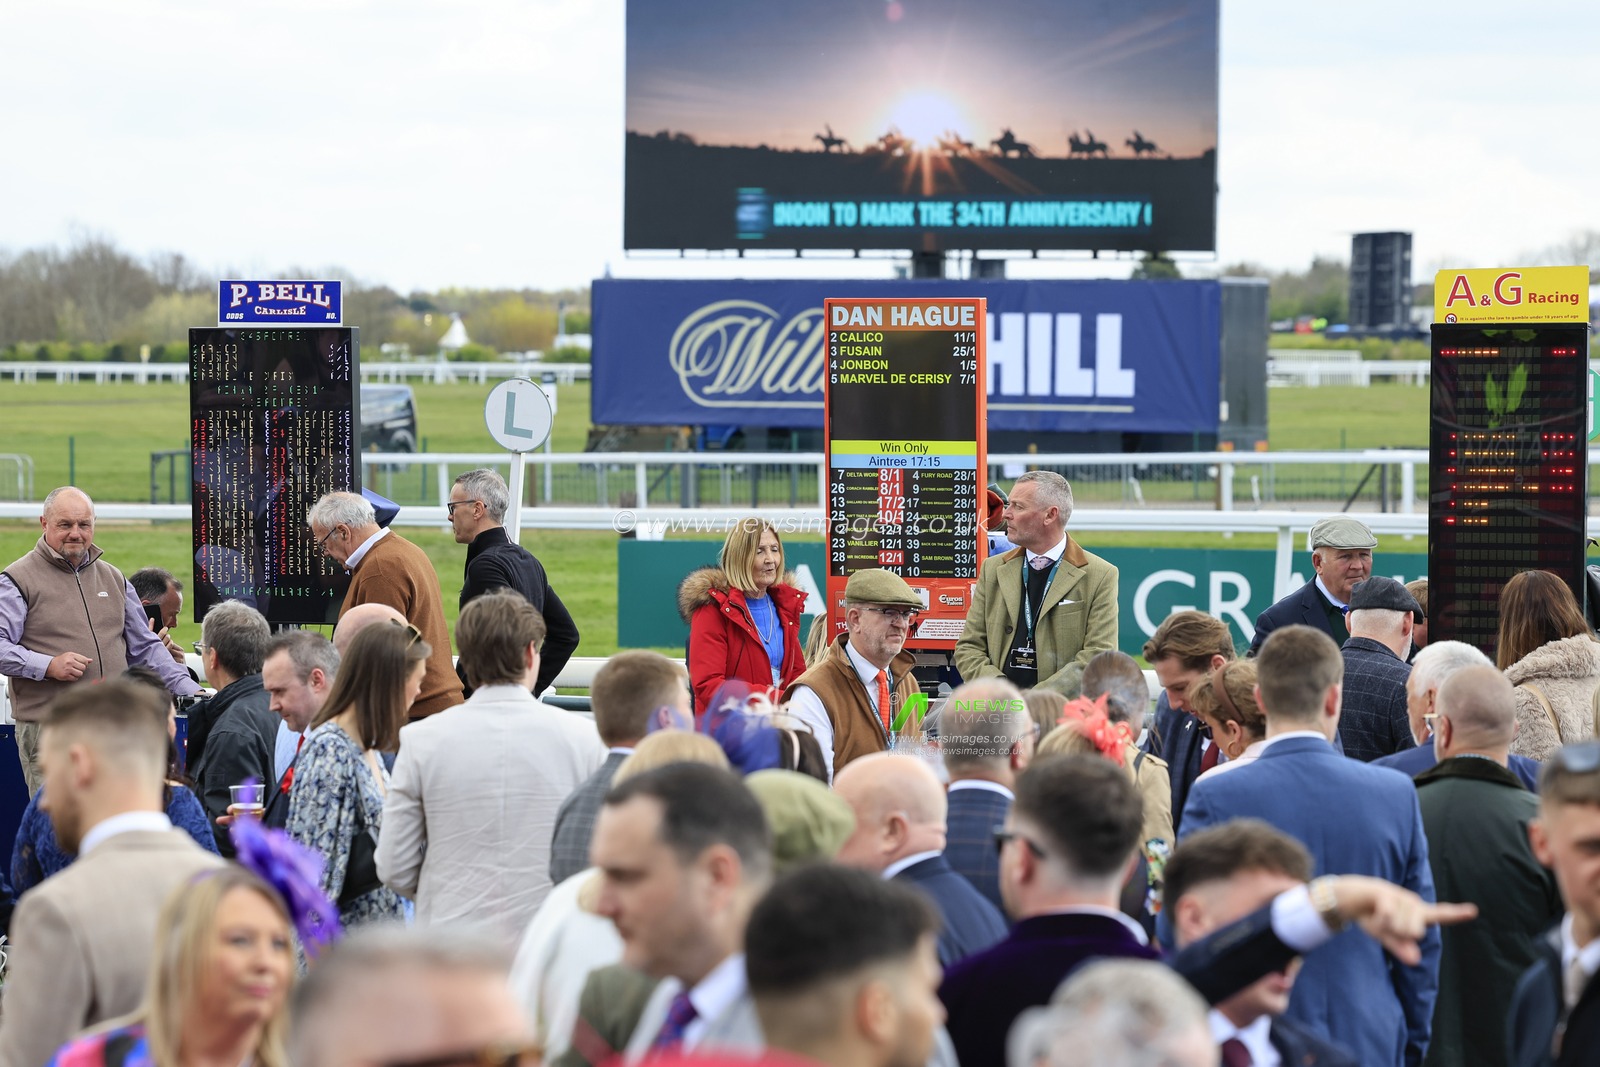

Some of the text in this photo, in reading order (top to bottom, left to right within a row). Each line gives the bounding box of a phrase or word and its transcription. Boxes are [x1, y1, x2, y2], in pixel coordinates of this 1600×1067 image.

[773, 202, 830, 227] NOON
[832, 202, 858, 227] TO
[860, 202, 915, 227] MARK
[918, 202, 954, 227] THE
[956, 202, 1006, 227] 34TH
[1008, 202, 1141, 227] ANNIVERSARY
[1446, 272, 1580, 308] A & G Racing
[230, 284, 330, 308] P. BELL
[254, 306, 306, 316] CARLISLE
[832, 306, 975, 326] DAN HAGUE
[830, 332, 976, 342] 2 CALICO 11/1
[669, 300, 1135, 400] Will HILL
[830, 346, 976, 356] 3 FUSAIN 25/1
[830, 360, 976, 370] 4 JONBON 1/5
[831, 374, 976, 384] 5 MARVEL DE CERISY 7/1
[504, 391, 533, 439] L
[880, 443, 928, 455] Win Only
[869, 456, 940, 466] Aintree 17:15
[838, 470, 844, 479] 7
[880, 469, 900, 481] 8/1
[912, 471, 919, 480] 4
[954, 471, 976, 481] 28/1
[831, 484, 845, 493] 26
[880, 484, 900, 495] 8/1
[913, 485, 919, 494] 9
[954, 485, 976, 494] 28/1
[832, 498, 845, 507] 13
[877, 496, 905, 509] 17/2
[907, 500, 919, 508] 17
[954, 499, 976, 509] 28/1
[832, 511, 845, 521] 25
[877, 510, 904, 523] 10/1
[907, 512, 920, 523] 24
[954, 513, 976, 523] 28/1
[880, 525, 901, 535] 12/1
[907, 526, 920, 536] 29
[954, 527, 976, 536] 28/1
[832, 538, 845, 548] 23
[880, 539, 901, 549] 12/1
[907, 540, 920, 550] 39
[954, 540, 976, 550] 28/1
[832, 552, 845, 562] 28
[880, 552, 902, 562] 12/1
[913, 553, 920, 563] 8
[954, 554, 976, 564] 33/1
[839, 566, 845, 575] 1
[880, 566, 901, 576] 4/1
[907, 568, 920, 576] 10
[954, 568, 976, 578] 33/1
[938, 594, 963, 604] Euros
